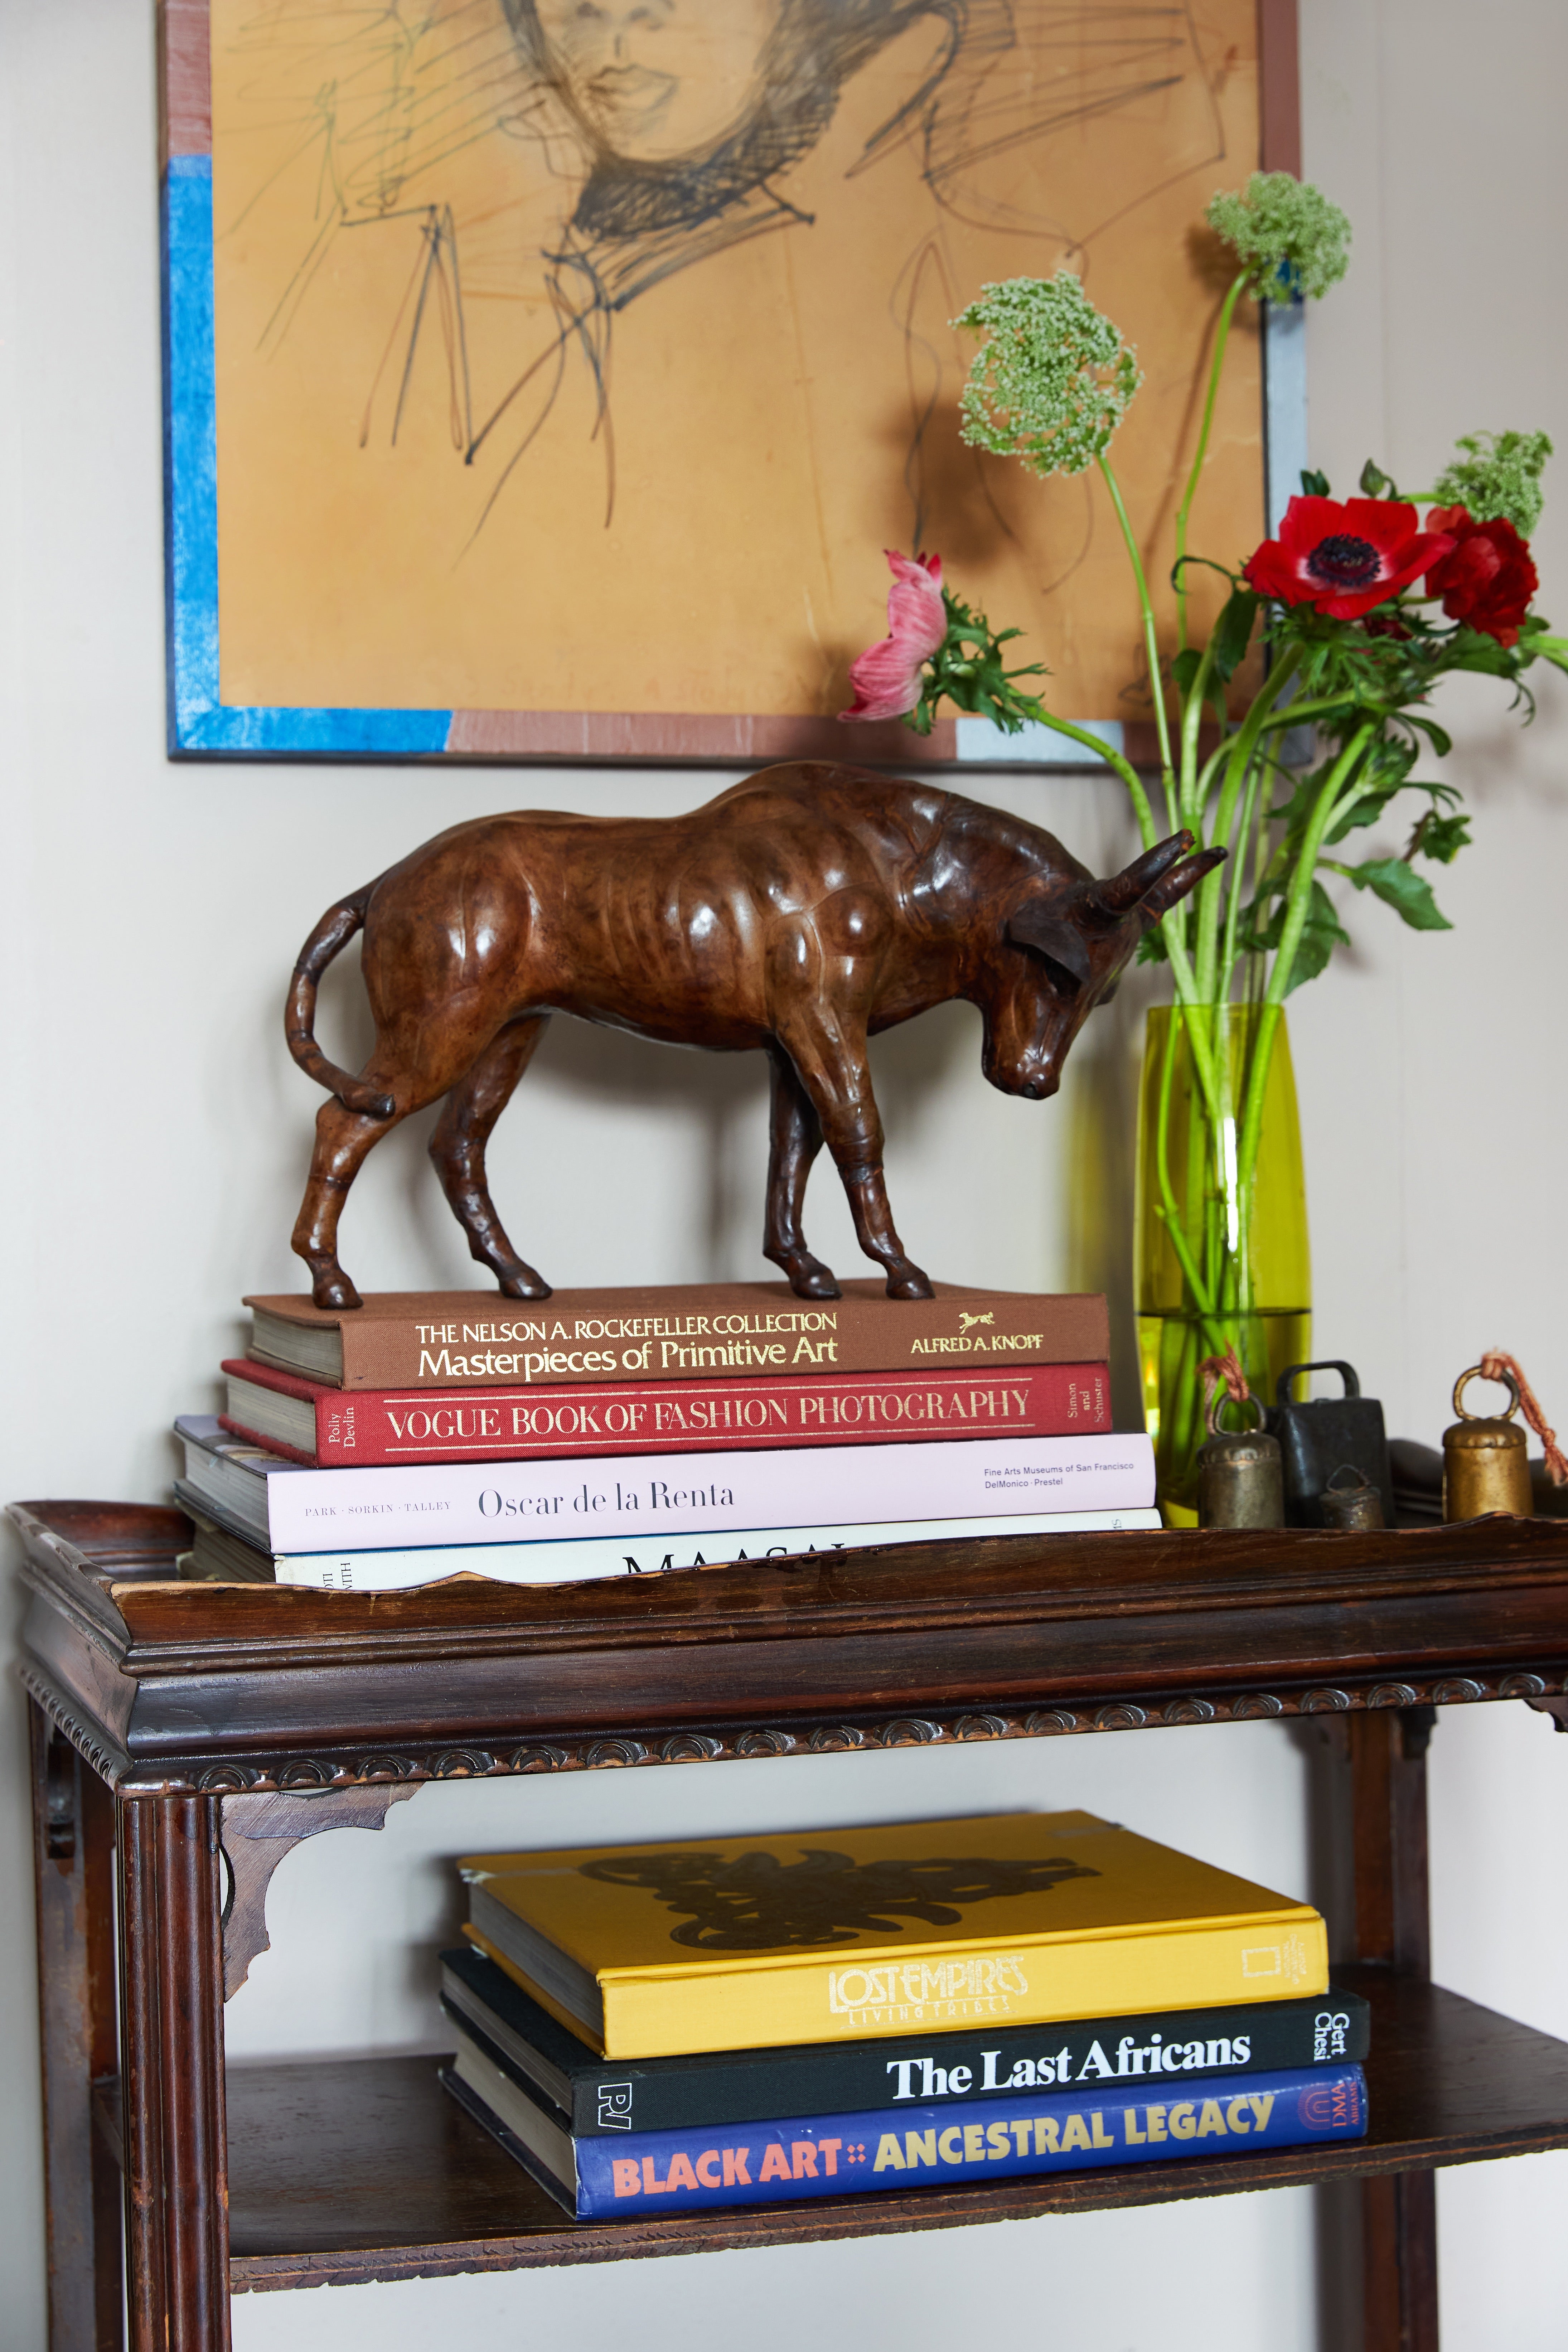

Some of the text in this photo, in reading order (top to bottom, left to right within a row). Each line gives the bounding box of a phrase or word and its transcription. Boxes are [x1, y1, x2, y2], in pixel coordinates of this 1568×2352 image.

[415, 1312, 837, 1343] THE NELSON A. ROCKEFELLER COLLECTION
[911, 1334, 1044, 1353] ALFRED A. KNOPF
[418, 1336, 838, 1382] Masterpieces of Primitive Art
[387, 1390, 1029, 1438] VOGUE BOOK OF FASHION PHOTOGRAPHY
[1067, 1383, 1078, 1418] Simon
[1079, 1391, 1090, 1410] and
[1093, 1377, 1104, 1422] Schuster
[328, 1413, 340, 1443] Polly
[343, 1407, 355, 1447] Devlin
[1034, 1478, 1063, 1486] Prestel
[1095, 1462, 1134, 1471] Francisco
[305, 1501, 451, 1516] PARK SORKIN TALLEY
[479, 1482, 735, 1517] Oscar de la Renta
[829, 1955, 1029, 2013] LOST EMPIRES
[849, 1996, 1010, 2025] LIVING TRIBES
[1313, 2012, 1332, 2062] Chesi
[1331, 2013, 1350, 2055] Gert
[886, 2033, 1250, 2100] The Last Africans
[1331, 2083, 1347, 2127] DMA
[612, 2096, 1274, 2197] BLACK ART ANCESTRAL LEGACY
